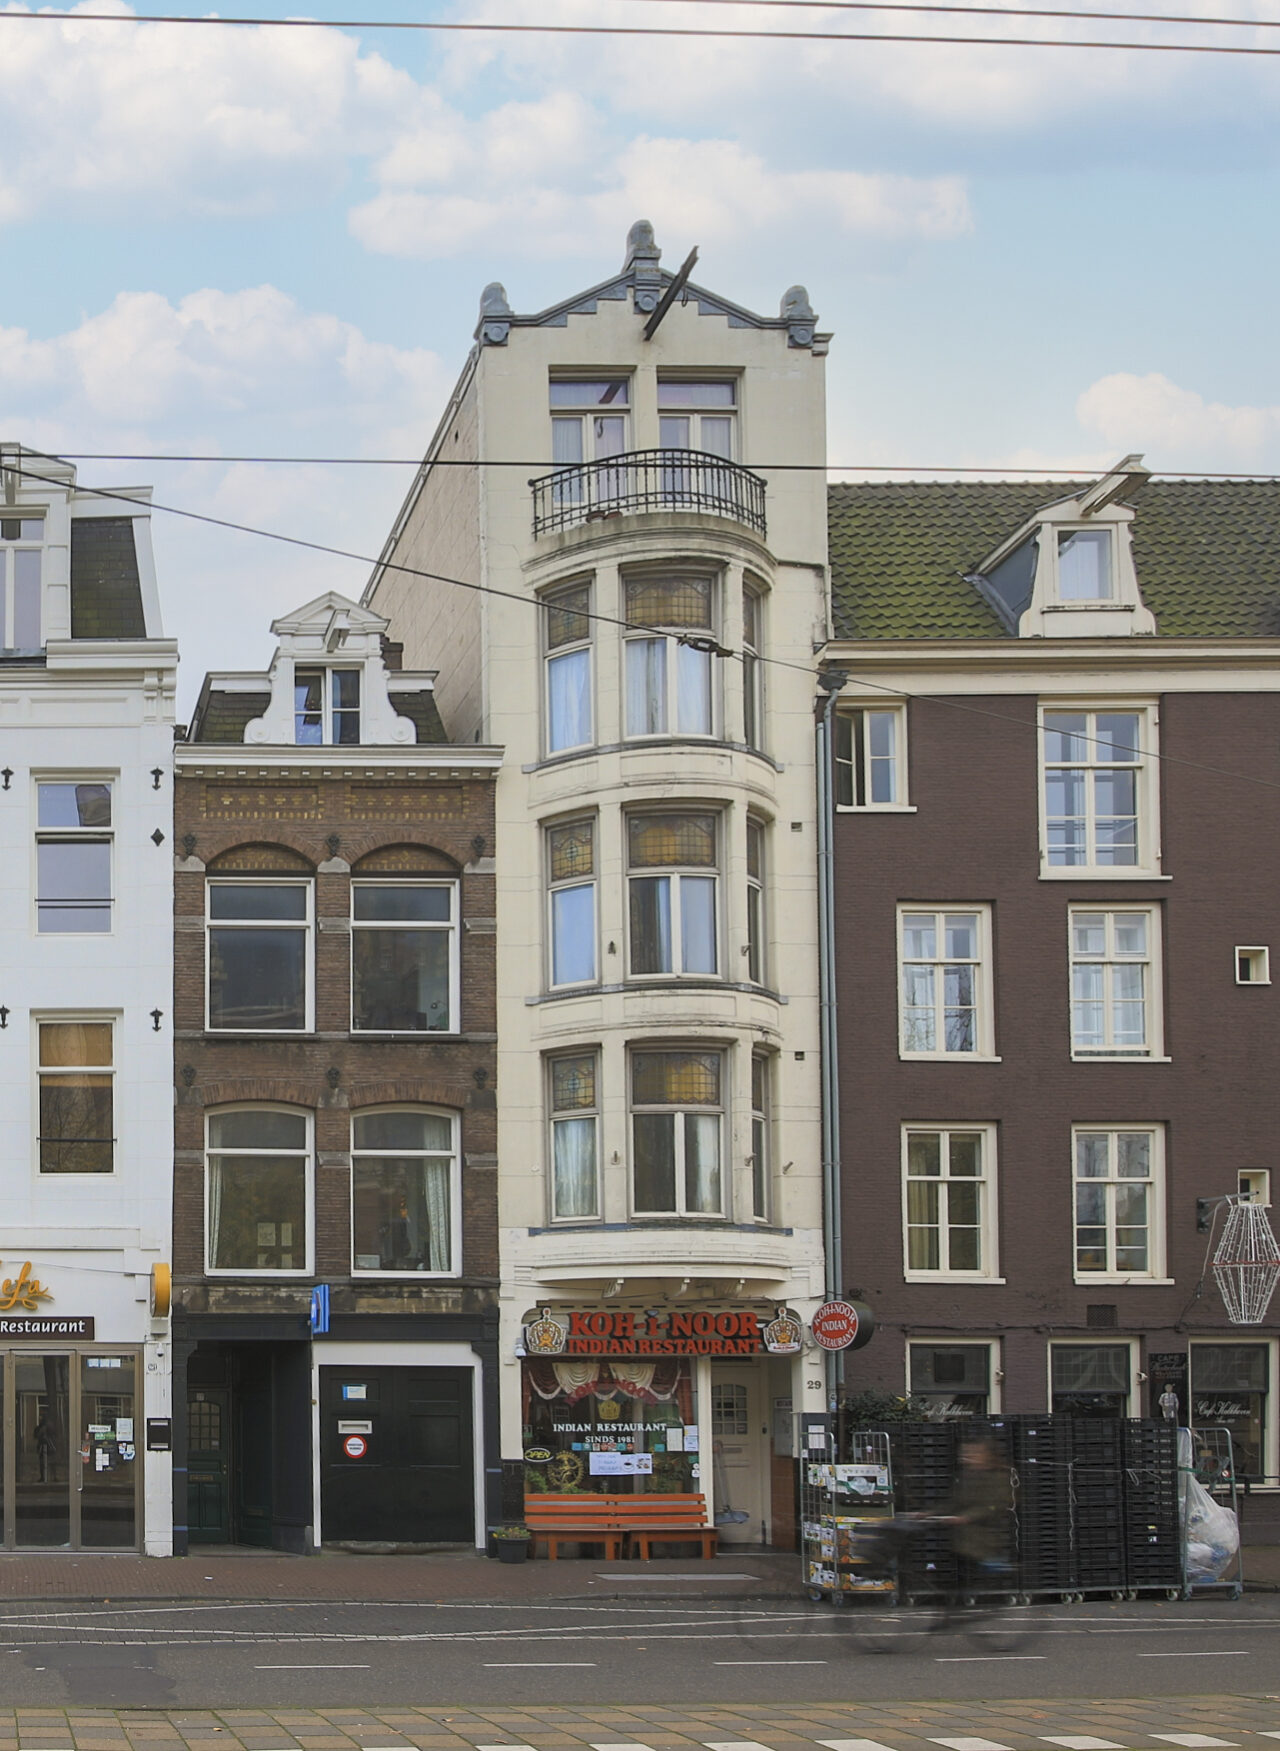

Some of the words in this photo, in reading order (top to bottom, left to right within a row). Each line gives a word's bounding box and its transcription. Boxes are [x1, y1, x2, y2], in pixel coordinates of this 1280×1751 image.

[0, 1320, 86, 1334] Restaurant
[821, 1320, 847, 1331] INDIAN
[569, 1340, 636, 1354] INDIAN
[639, 1339, 762, 1354] RESTAURANT
[807, 1380, 821, 1390] 29
[553, 1423, 591, 1432] INDIAN
[597, 1423, 667, 1432] RESTAURANT
[525, 1450, 550, 1459] OPEN
